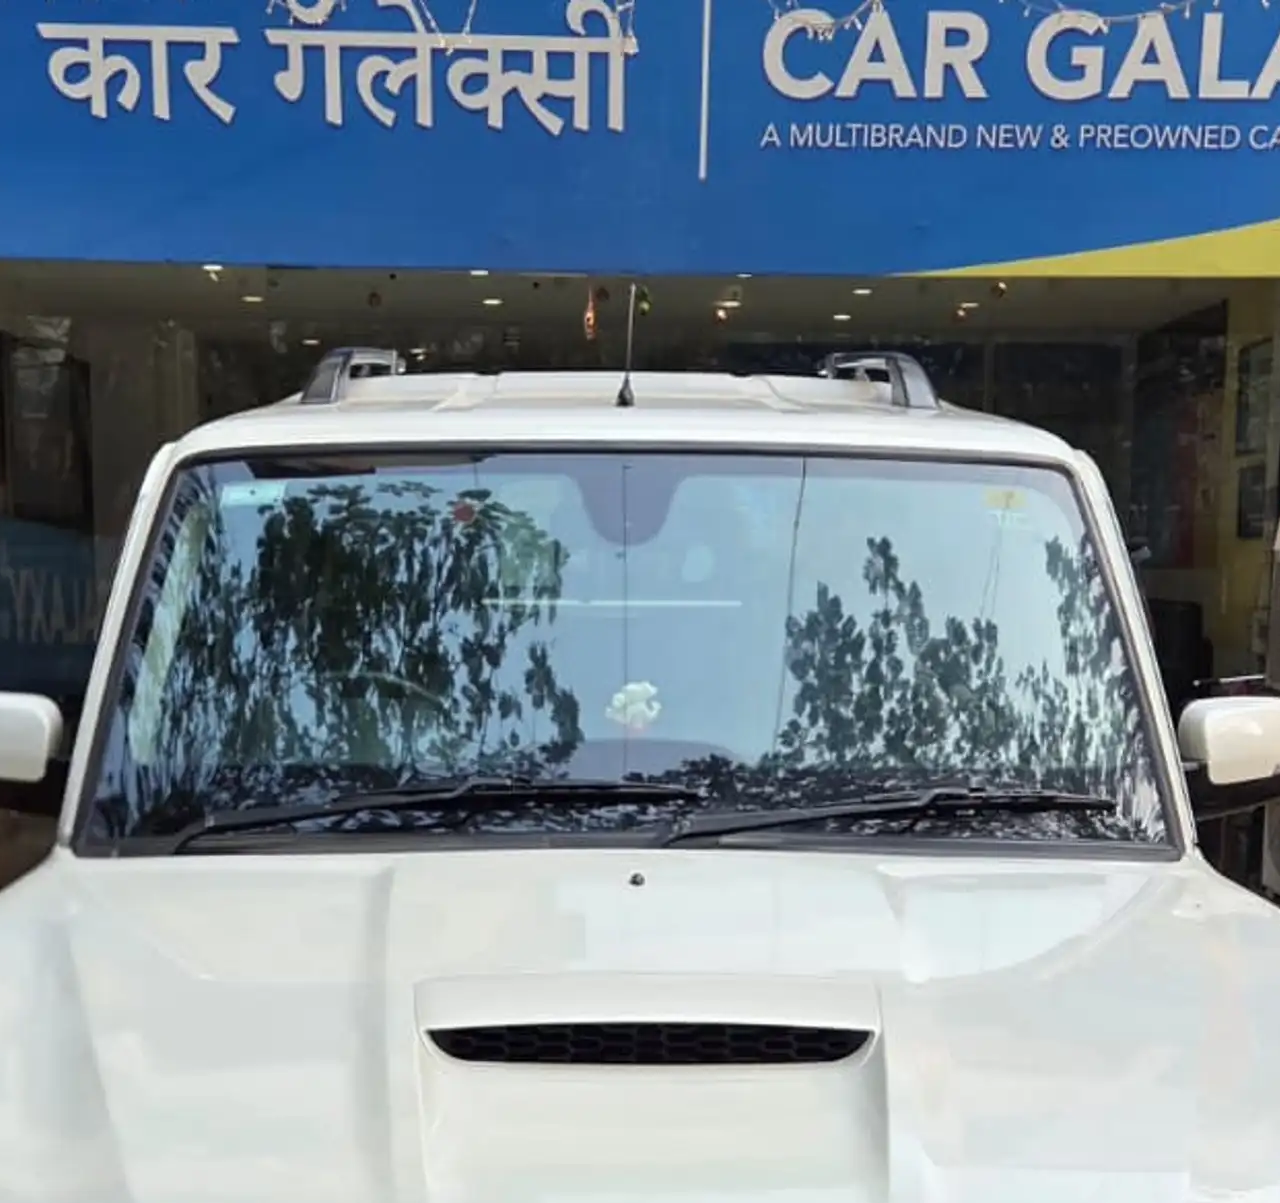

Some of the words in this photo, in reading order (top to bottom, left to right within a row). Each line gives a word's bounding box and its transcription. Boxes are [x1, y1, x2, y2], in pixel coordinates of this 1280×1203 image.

[36, 22, 240, 124] कार
[763, 8, 990, 101] CAR
[760, 125, 781, 147] A
[789, 123, 968, 148] MULTIBRAND
[976, 125, 1043, 148] NEW
[1050, 125, 1069, 148] &
[1078, 125, 1242, 149] PREOWNED
